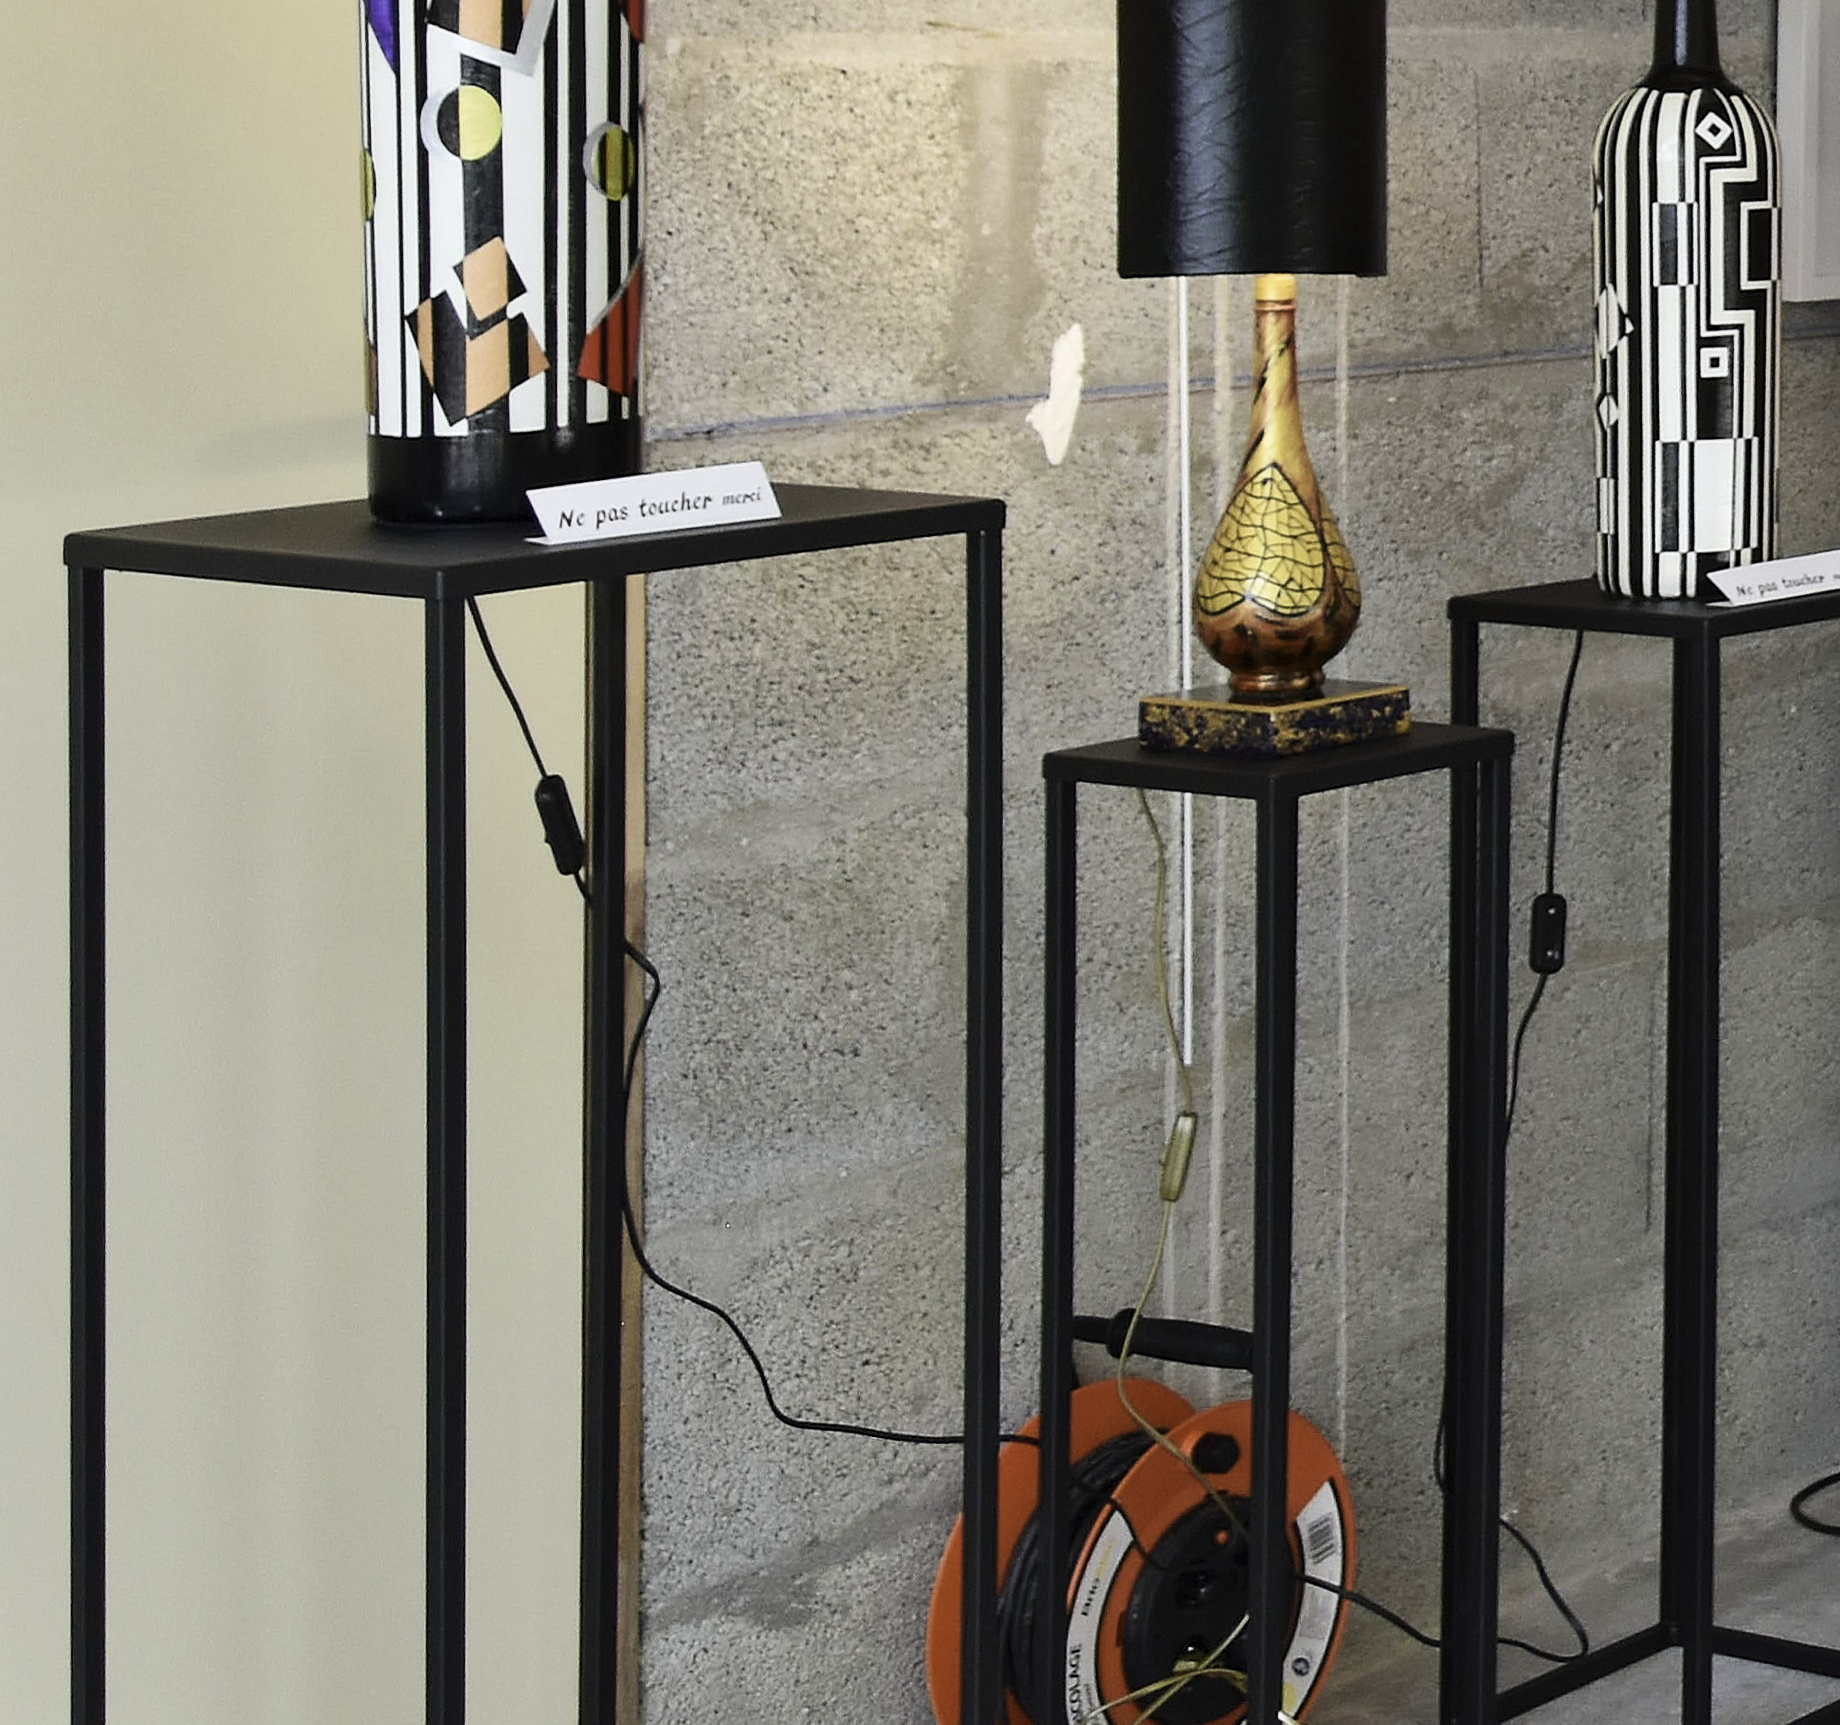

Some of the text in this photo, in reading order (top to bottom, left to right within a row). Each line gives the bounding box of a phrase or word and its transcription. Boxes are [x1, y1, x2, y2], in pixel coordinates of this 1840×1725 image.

[557, 486, 763, 531] Ne pas toucher merci
[1757, 581, 1779, 597] pas
[1781, 572, 1826, 589] toucher
